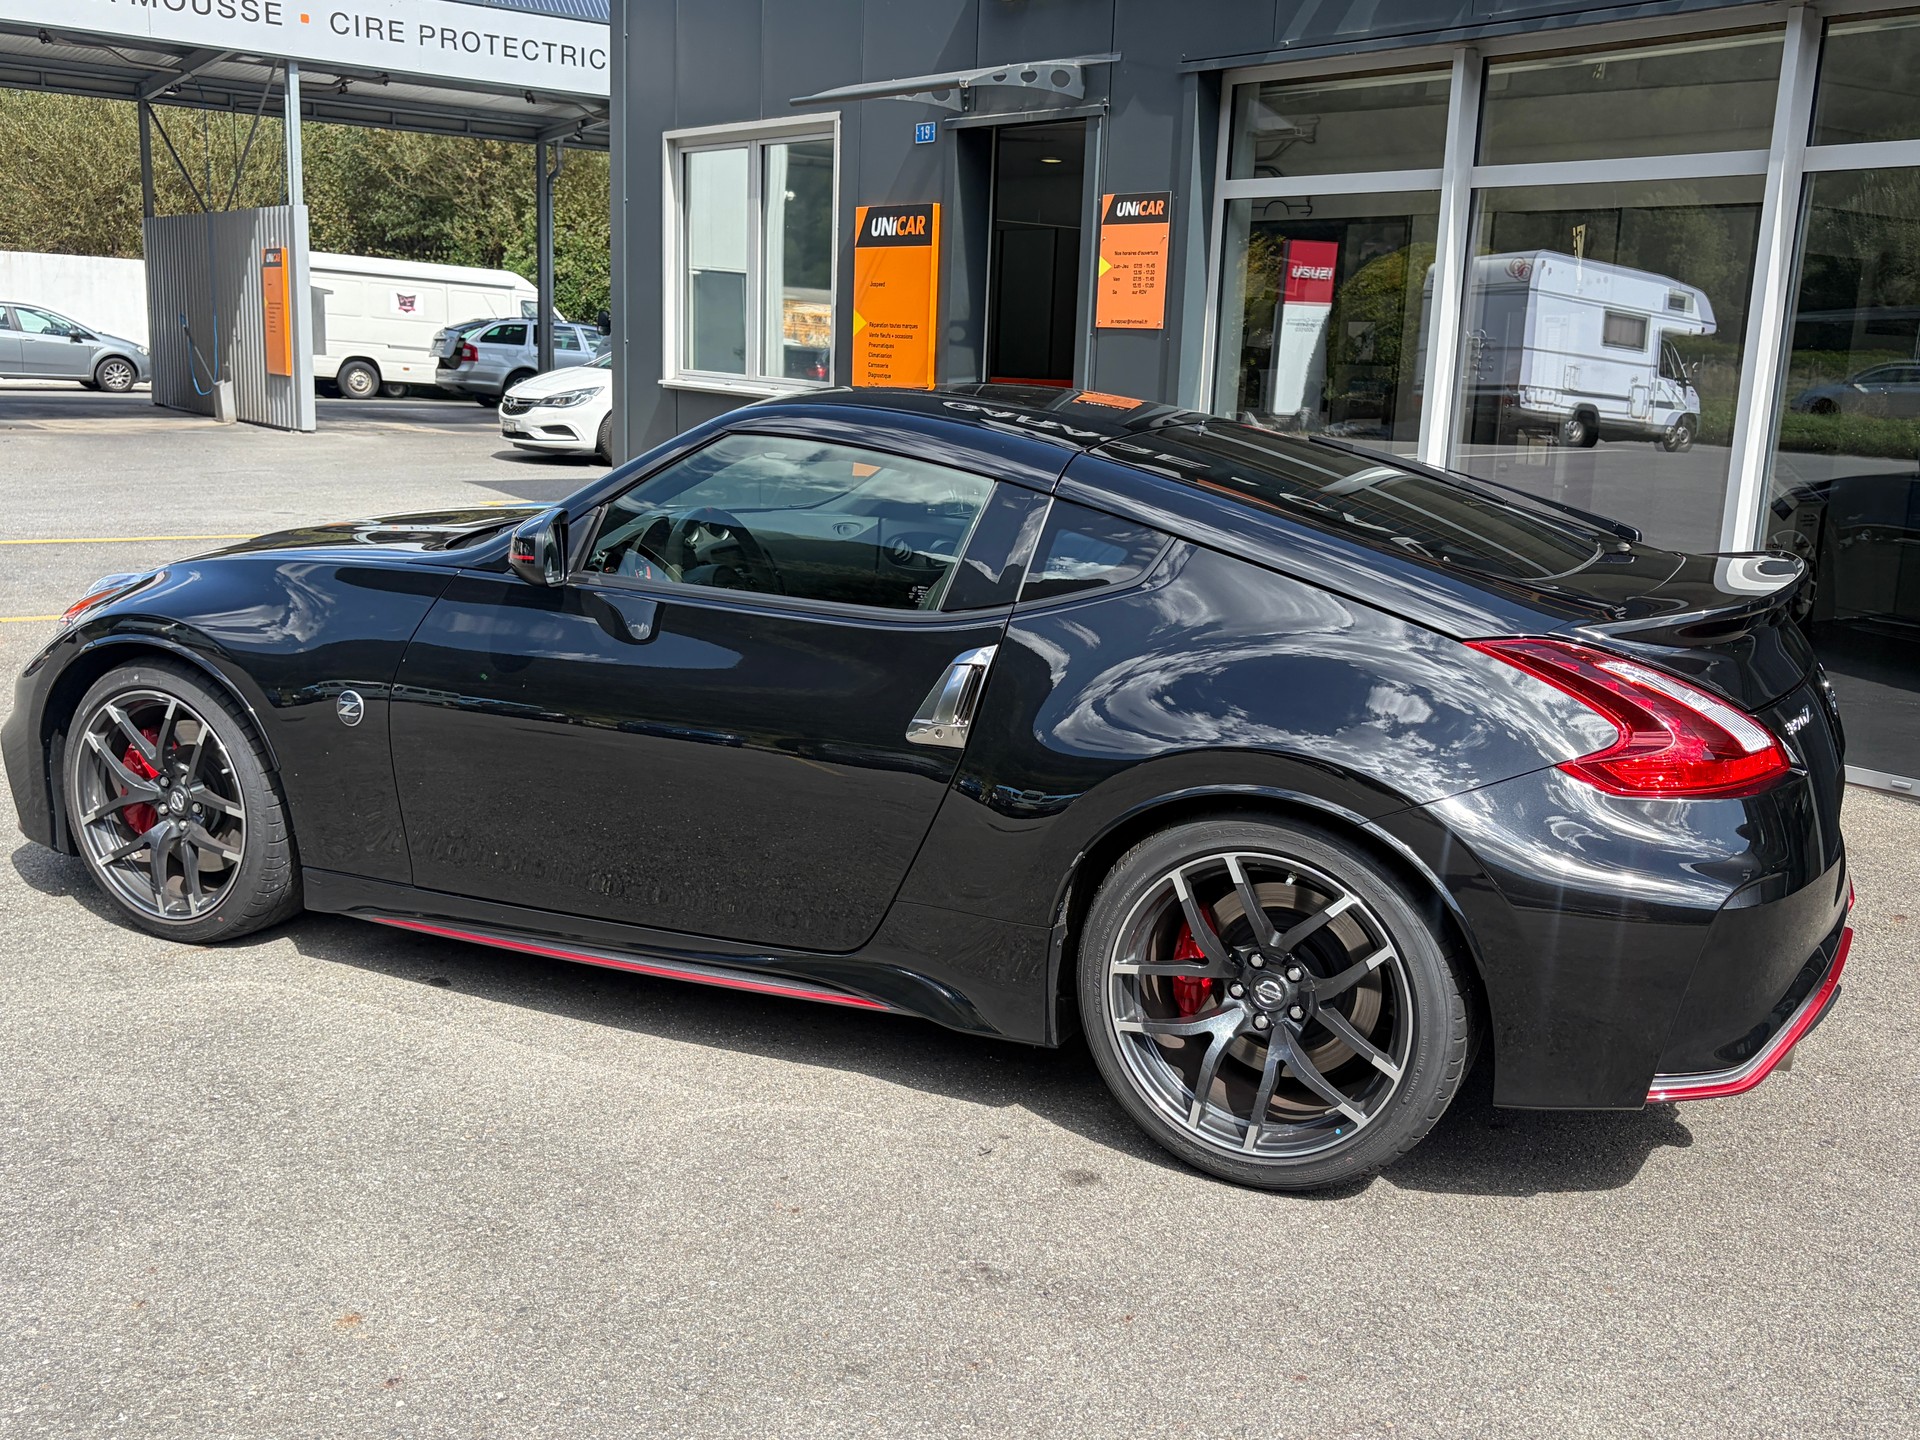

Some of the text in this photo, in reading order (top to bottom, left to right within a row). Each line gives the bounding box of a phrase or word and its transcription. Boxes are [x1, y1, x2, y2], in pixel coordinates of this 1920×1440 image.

[329, 11, 405, 43] CIRE
[419, 24, 606, 70] PROTECTRIC
[919, 125, 931, 140] 19
[868, 341, 895, 349] Pneumatiques
[867, 371, 892, 379] Diagnostique
